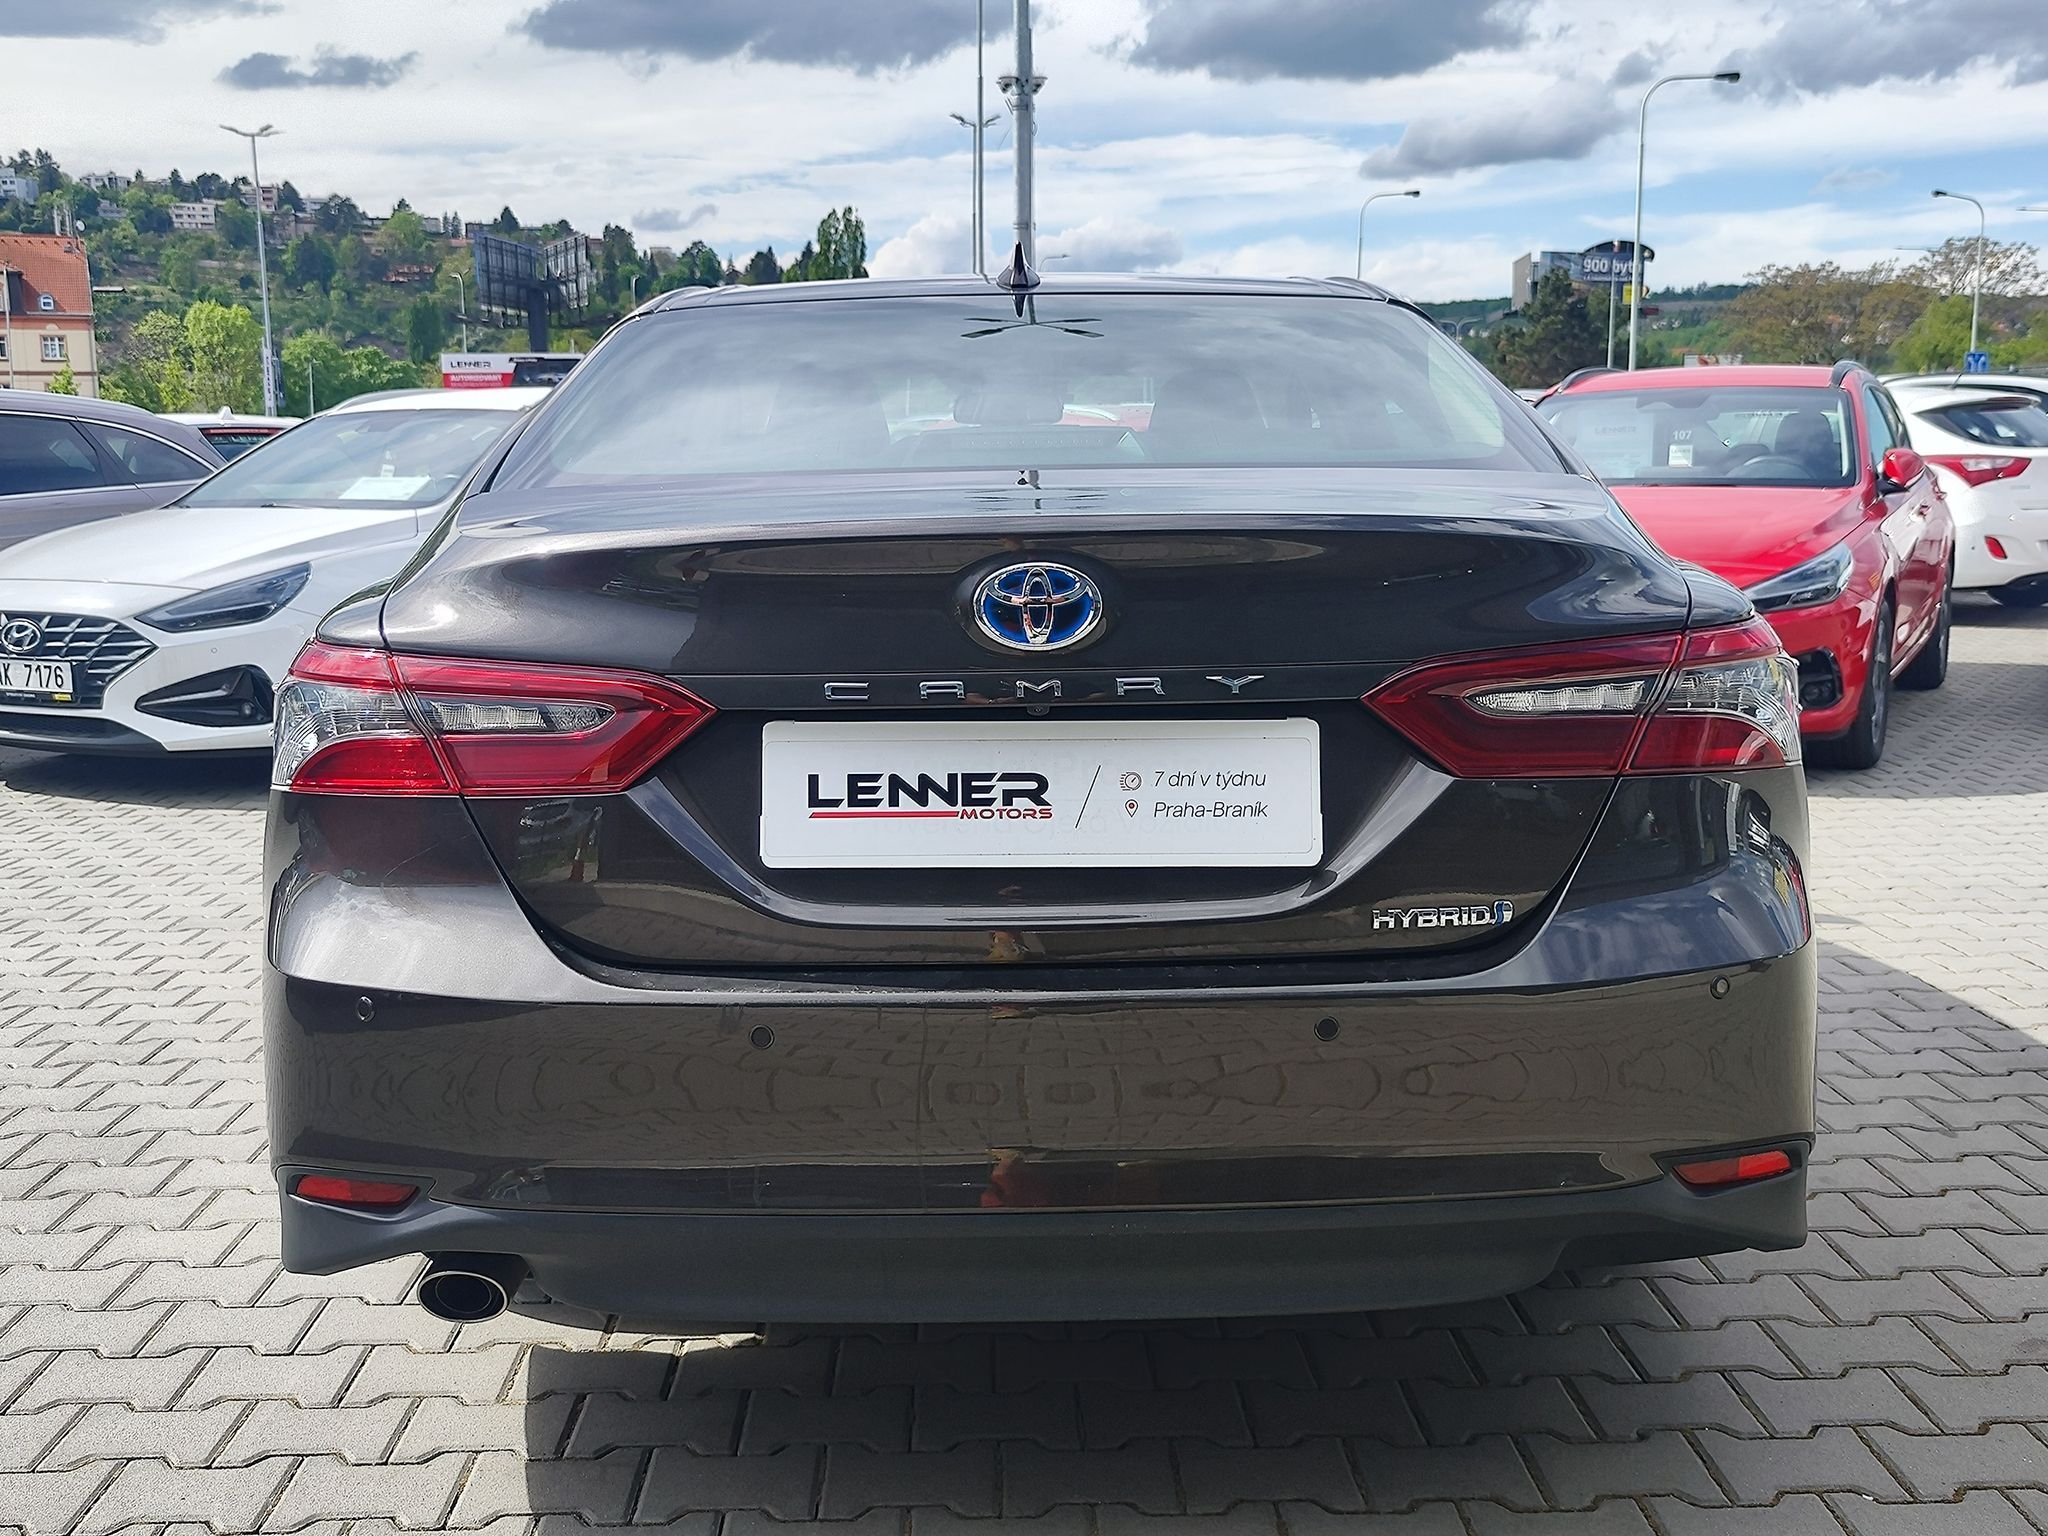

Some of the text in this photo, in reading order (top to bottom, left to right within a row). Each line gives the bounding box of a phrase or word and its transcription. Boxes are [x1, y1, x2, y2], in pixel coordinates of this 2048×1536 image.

[1583, 257, 1608, 273] 900
[1673, 430, 1692, 440] 107
[24, 664, 64, 688] 7176
[824, 674, 1265, 700] CAMRY
[1154, 770, 1267, 790] 7 dní v týdnu
[807, 773, 1053, 808] LENNER
[959, 808, 1053, 820] MOTORS
[1153, 801, 1269, 818] Praha-Braník
[1372, 905, 1492, 930] HYBRID
